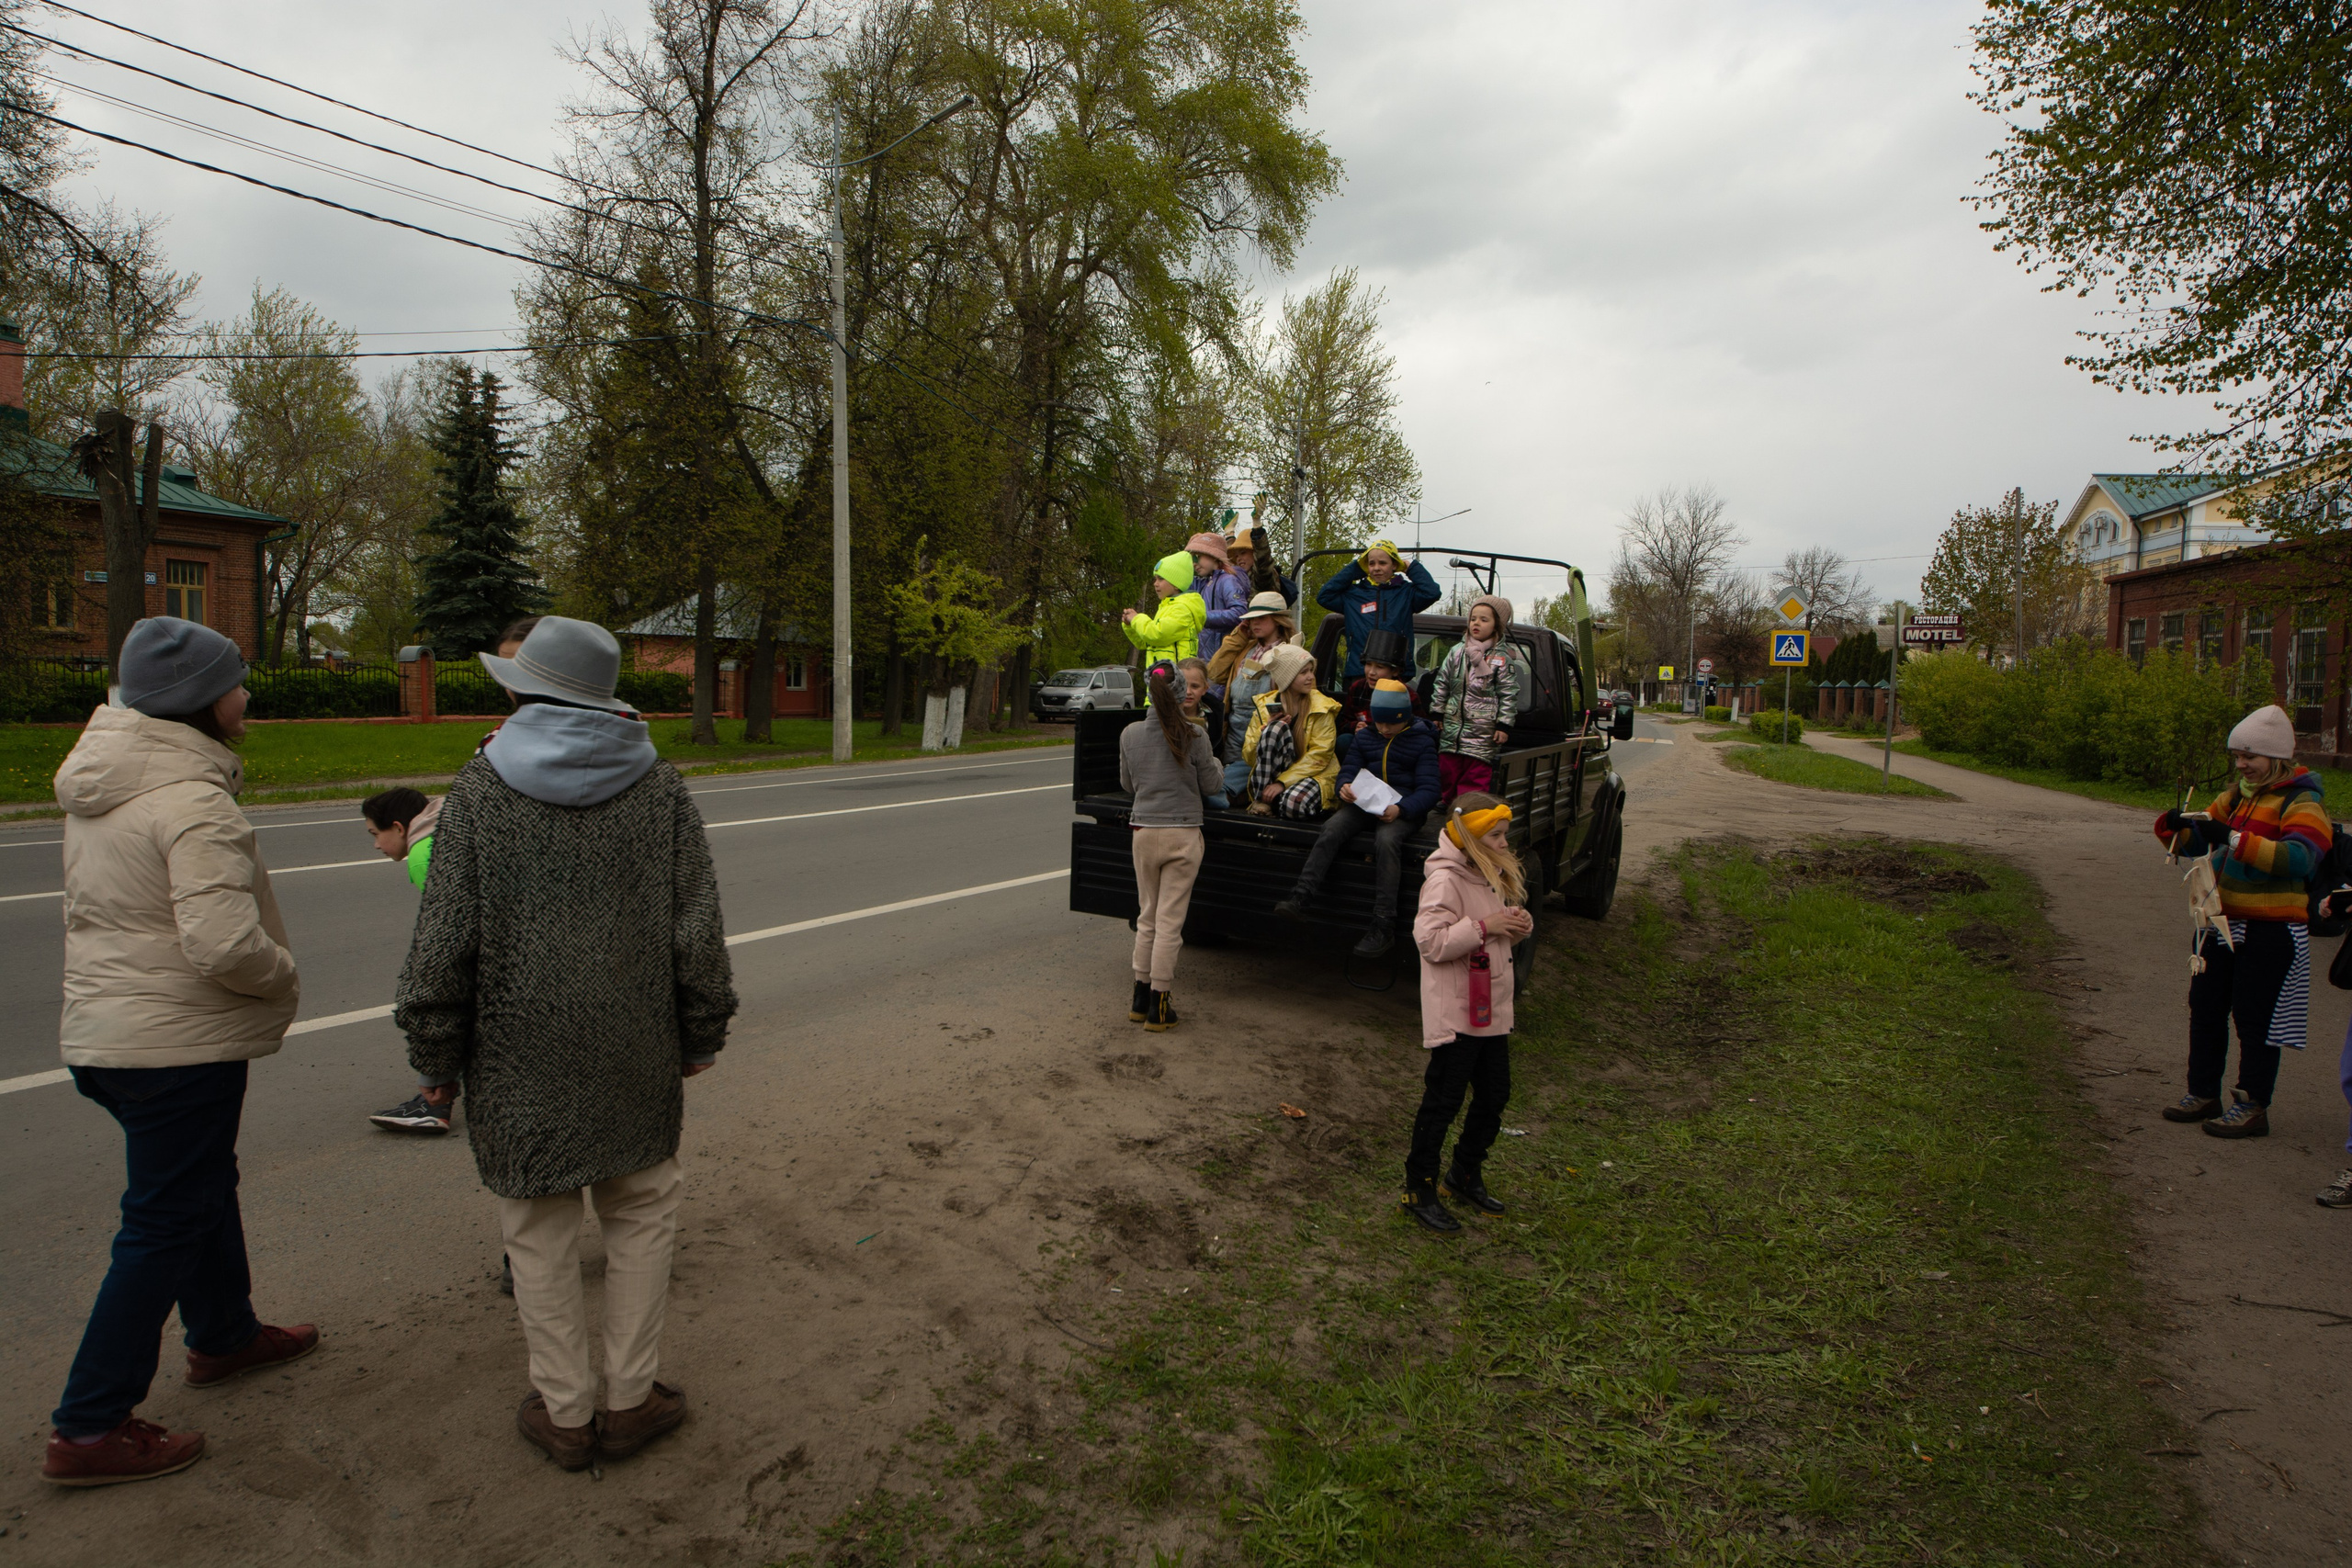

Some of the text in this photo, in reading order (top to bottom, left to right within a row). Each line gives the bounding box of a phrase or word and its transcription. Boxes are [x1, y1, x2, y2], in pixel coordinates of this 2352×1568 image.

[146, 574, 155, 582] 20
[1914, 615, 1959, 625] РЕСТОРАЦИЯ
[1905, 629, 1962, 641] MOTEL
